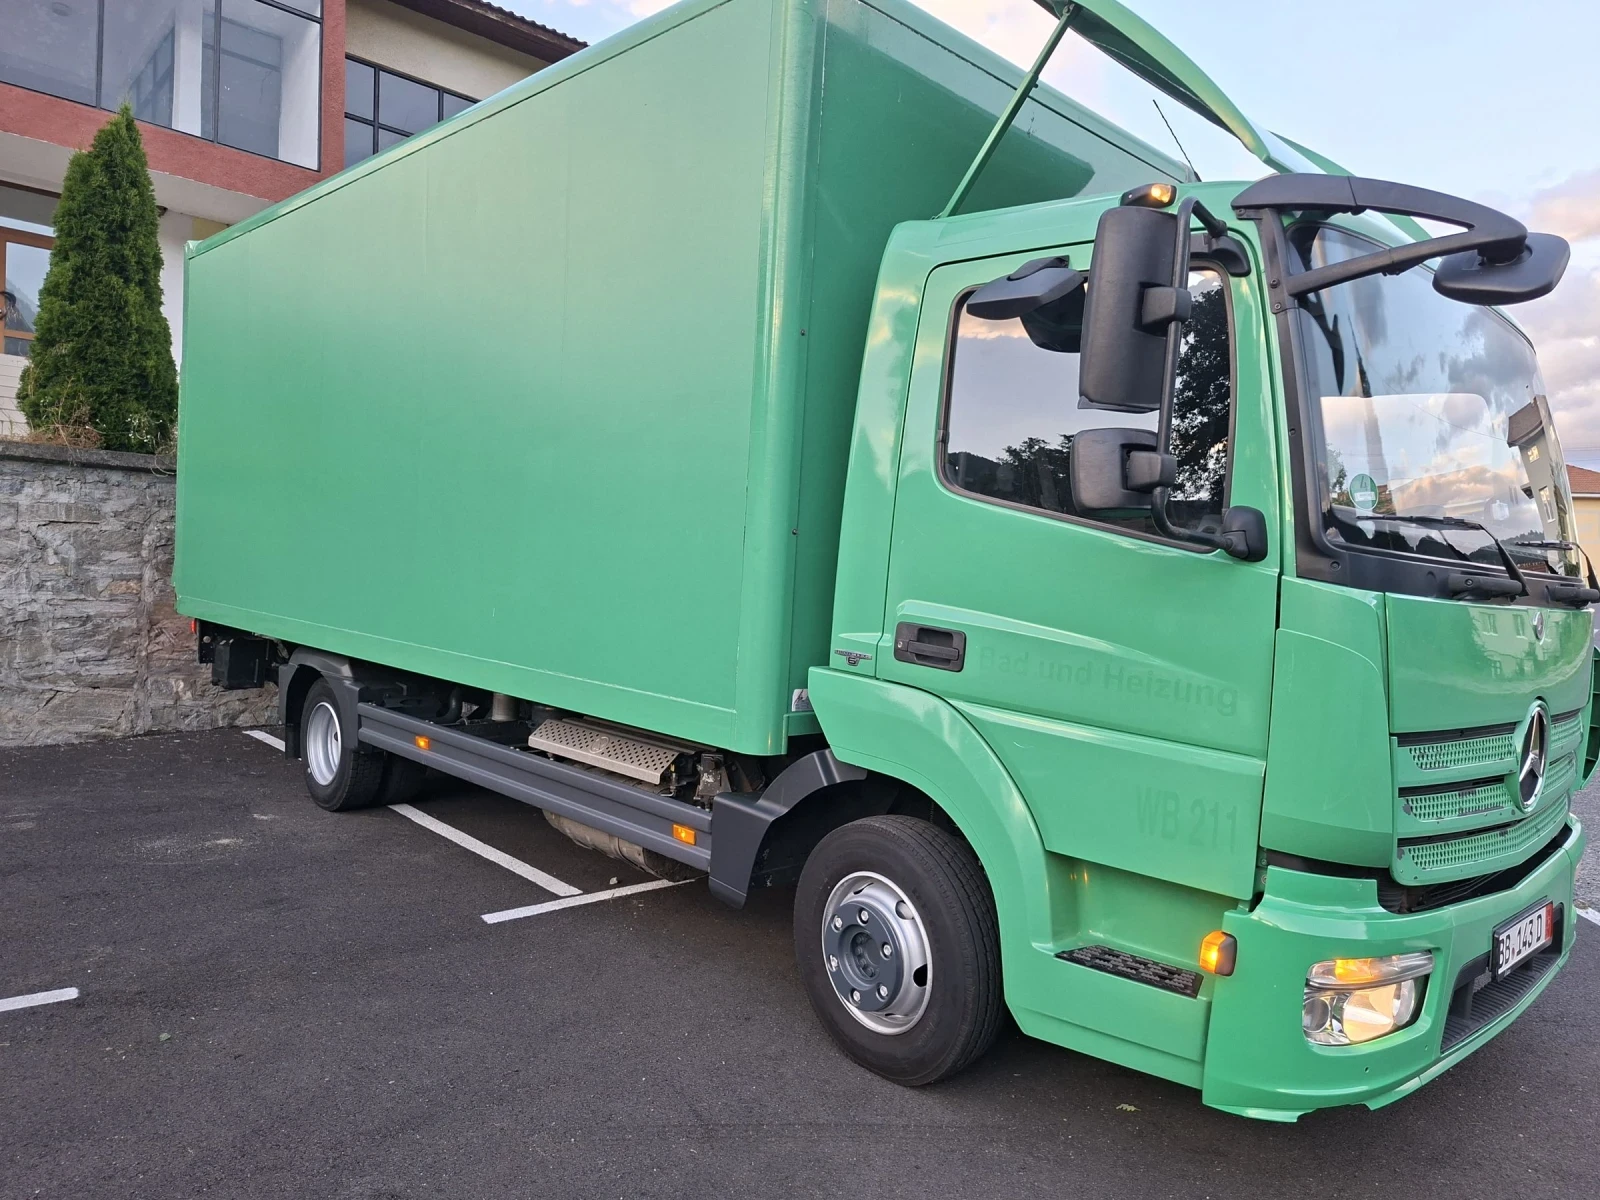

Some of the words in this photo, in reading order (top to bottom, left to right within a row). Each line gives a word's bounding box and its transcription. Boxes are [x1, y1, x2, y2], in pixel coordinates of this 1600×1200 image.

[980, 647, 1029, 676] Bad
[1039, 660, 1093, 685] und
[1104, 663, 1239, 717] Heizung
[1135, 784, 1181, 840] WB
[1188, 798, 1238, 853] 211
[1517, 919, 1534, 956] 143
[1536, 914, 1542, 942] D
